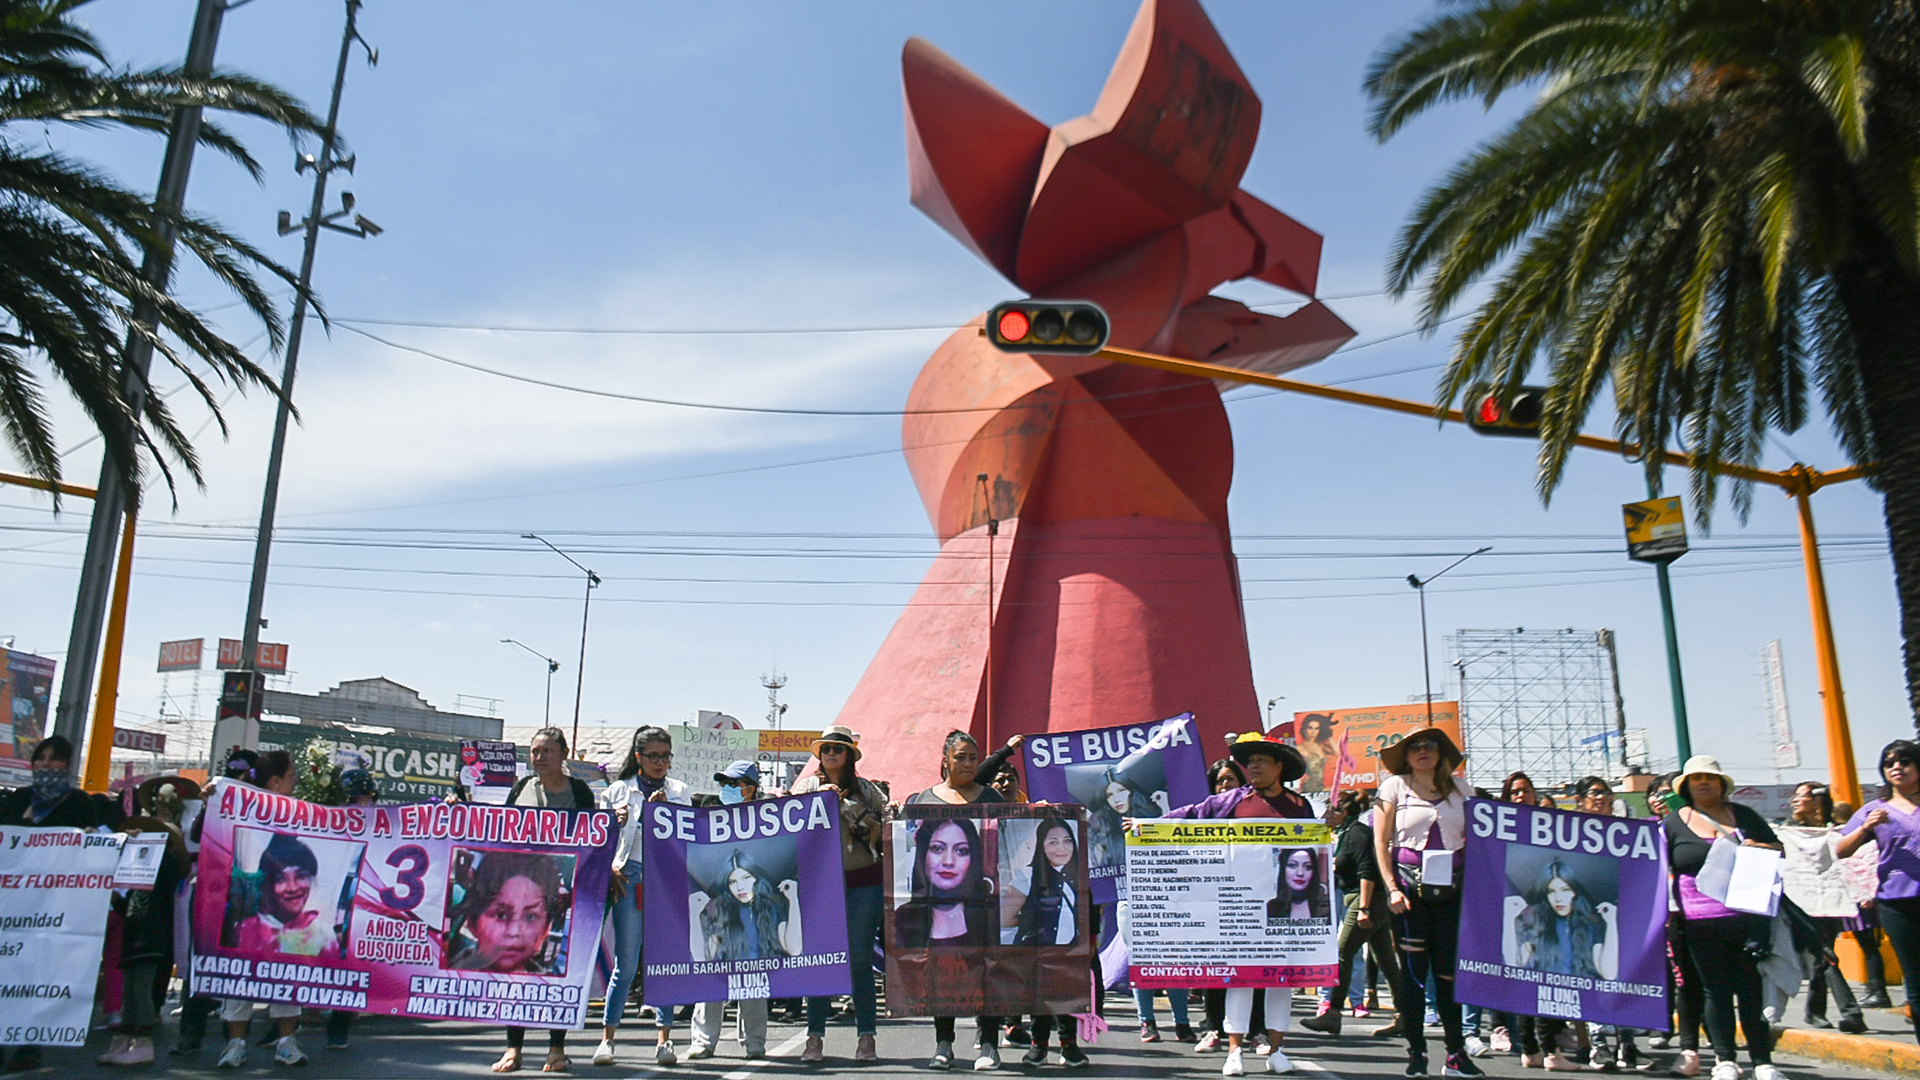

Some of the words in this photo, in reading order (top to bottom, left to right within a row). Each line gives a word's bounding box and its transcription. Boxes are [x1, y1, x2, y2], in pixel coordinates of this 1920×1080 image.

[161, 641, 198, 662] HOTEL
[219, 641, 283, 665] HOEL
[1343, 711, 1388, 723] INTERNET
[115, 730, 162, 751] OTEL
[683, 724, 702, 744] Del
[707, 731, 748, 752] Mazo
[771, 732, 819, 749] elektr
[1031, 735, 1072, 768] SE
[1081, 718, 1193, 762] BUSCA
[389, 781, 454, 797] JOYERIA
[1341, 772, 1376, 787] kyHD
[219, 785, 365, 835] AYUDANOS
[374, 808, 391, 836] A
[400, 805, 609, 847] ENCONTRARLAS
[652, 805, 696, 842] SE
[708, 796, 832, 843] BUSCA
[9, 835, 21, 849] y
[23, 832, 82, 848] JUSTICIA
[1172, 826, 1238, 837] ALERTA
[1242, 825, 1288, 837] NEZA
[1472, 802, 1518, 841] SE
[1531, 810, 1658, 861] BUSCA
[1151, 849, 1159, 857] DE
[1209, 857, 1226, 865] AÑOS
[25, 873, 114, 890] FLORENCIO
[379, 844, 429, 911] 3
[1089, 865, 1118, 879] ARAHI
[366, 918, 405, 939] AÑOS
[408, 923, 427, 940] DE
[356, 939, 431, 962] BUSQUEDA
[647, 962, 690, 976] NAHOMI
[693, 962, 732, 975] SARAHI
[735, 957, 780, 972] ROMERO
[782, 951, 847, 969] HERNANDEZ
[1206, 966, 1238, 977] NEZA
[1262, 967, 1333, 977] 57-43-43-43
[256, 961, 370, 988] GUADALUPE
[728, 974, 742, 989] NI
[743, 972, 770, 988] UNA
[1459, 958, 1502, 977] NAHOMI
[1503, 966, 1544, 983] SARAHI
[1546, 973, 1592, 990] ROMERO
[1595, 979, 1664, 998] HERNANDEZ
[297, 986, 367, 1008] OLVERA
[410, 975, 481, 997] EVELIN
[487, 980, 582, 1005] MARISO
[728, 985, 771, 1000] MENOS
[1537, 985, 1551, 1001] NI
[1553, 988, 1581, 1004] UNA
[406, 997, 498, 1020] MARTÍNEZ
[500, 1004, 580, 1026] BALTAZA
[1537, 1000, 1582, 1019] MENOS
[4, 1026, 22, 1042] SE
[24, 1026, 87, 1043] OLVIDA
